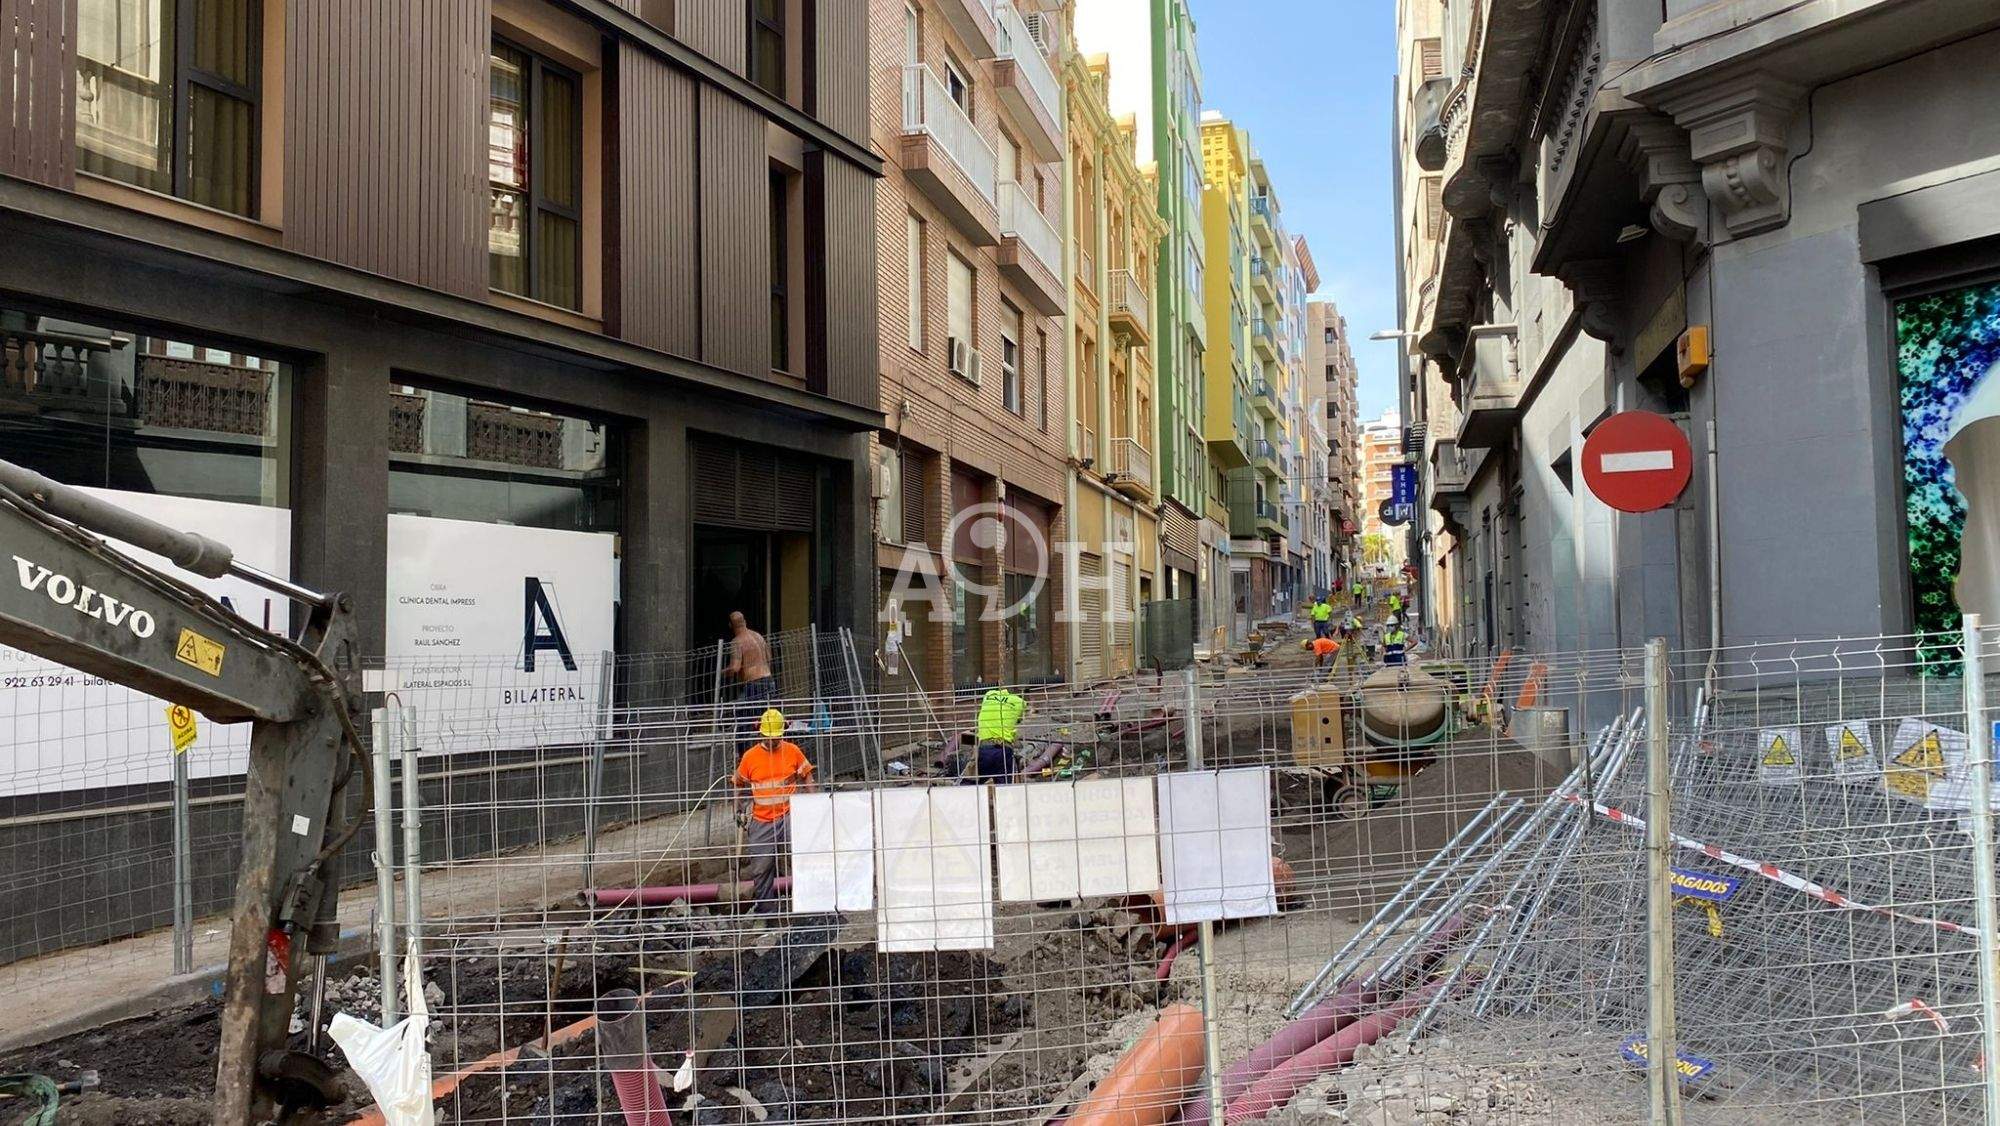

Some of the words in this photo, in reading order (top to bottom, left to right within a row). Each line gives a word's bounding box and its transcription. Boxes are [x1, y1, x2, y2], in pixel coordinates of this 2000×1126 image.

[12, 555, 156, 639] VOLVO
[426, 597, 449, 605] DENTAL
[450, 598, 476, 606] IMPRESS
[4, 677, 26, 687] 922
[31, 676, 44, 687] 63
[48, 676, 62, 687] 29
[64, 676, 74, 686] 41
[504, 686, 585, 704] BILATERAL
[1669, 872, 1731, 894] RAGADOS
